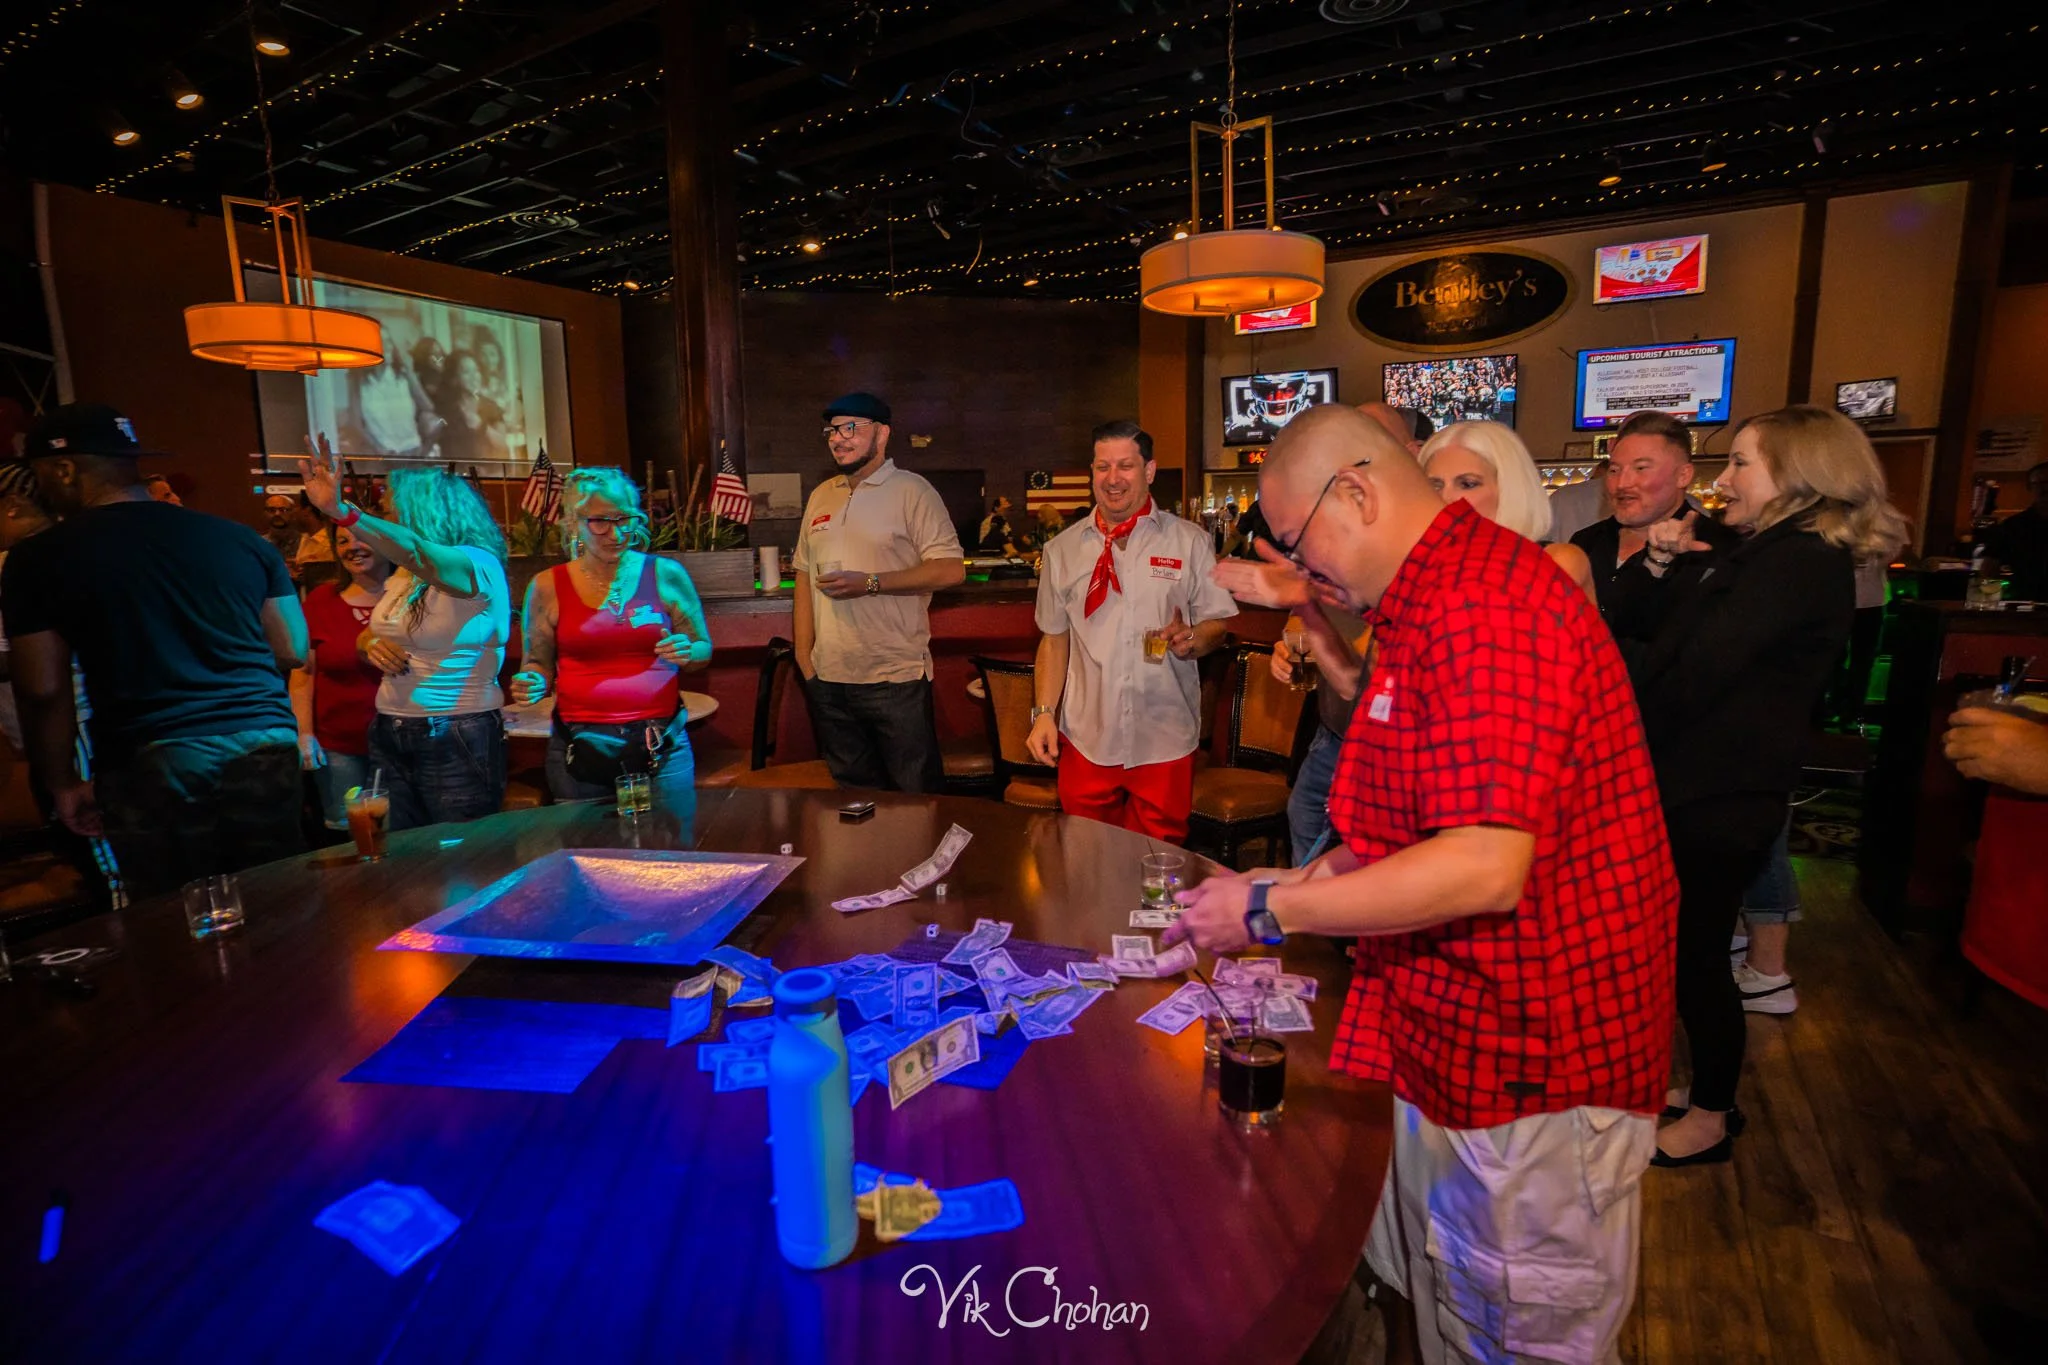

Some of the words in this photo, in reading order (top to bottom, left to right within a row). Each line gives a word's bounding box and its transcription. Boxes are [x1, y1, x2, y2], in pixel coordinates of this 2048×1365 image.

[1395, 268, 1538, 309] Bentley's
[1590, 354, 1629, 362] UPCOMING
[1631, 350, 1663, 360] TOURIST
[1664, 347, 1718, 357] ATTRACTIONS
[1157, 557, 1175, 566] Hello
